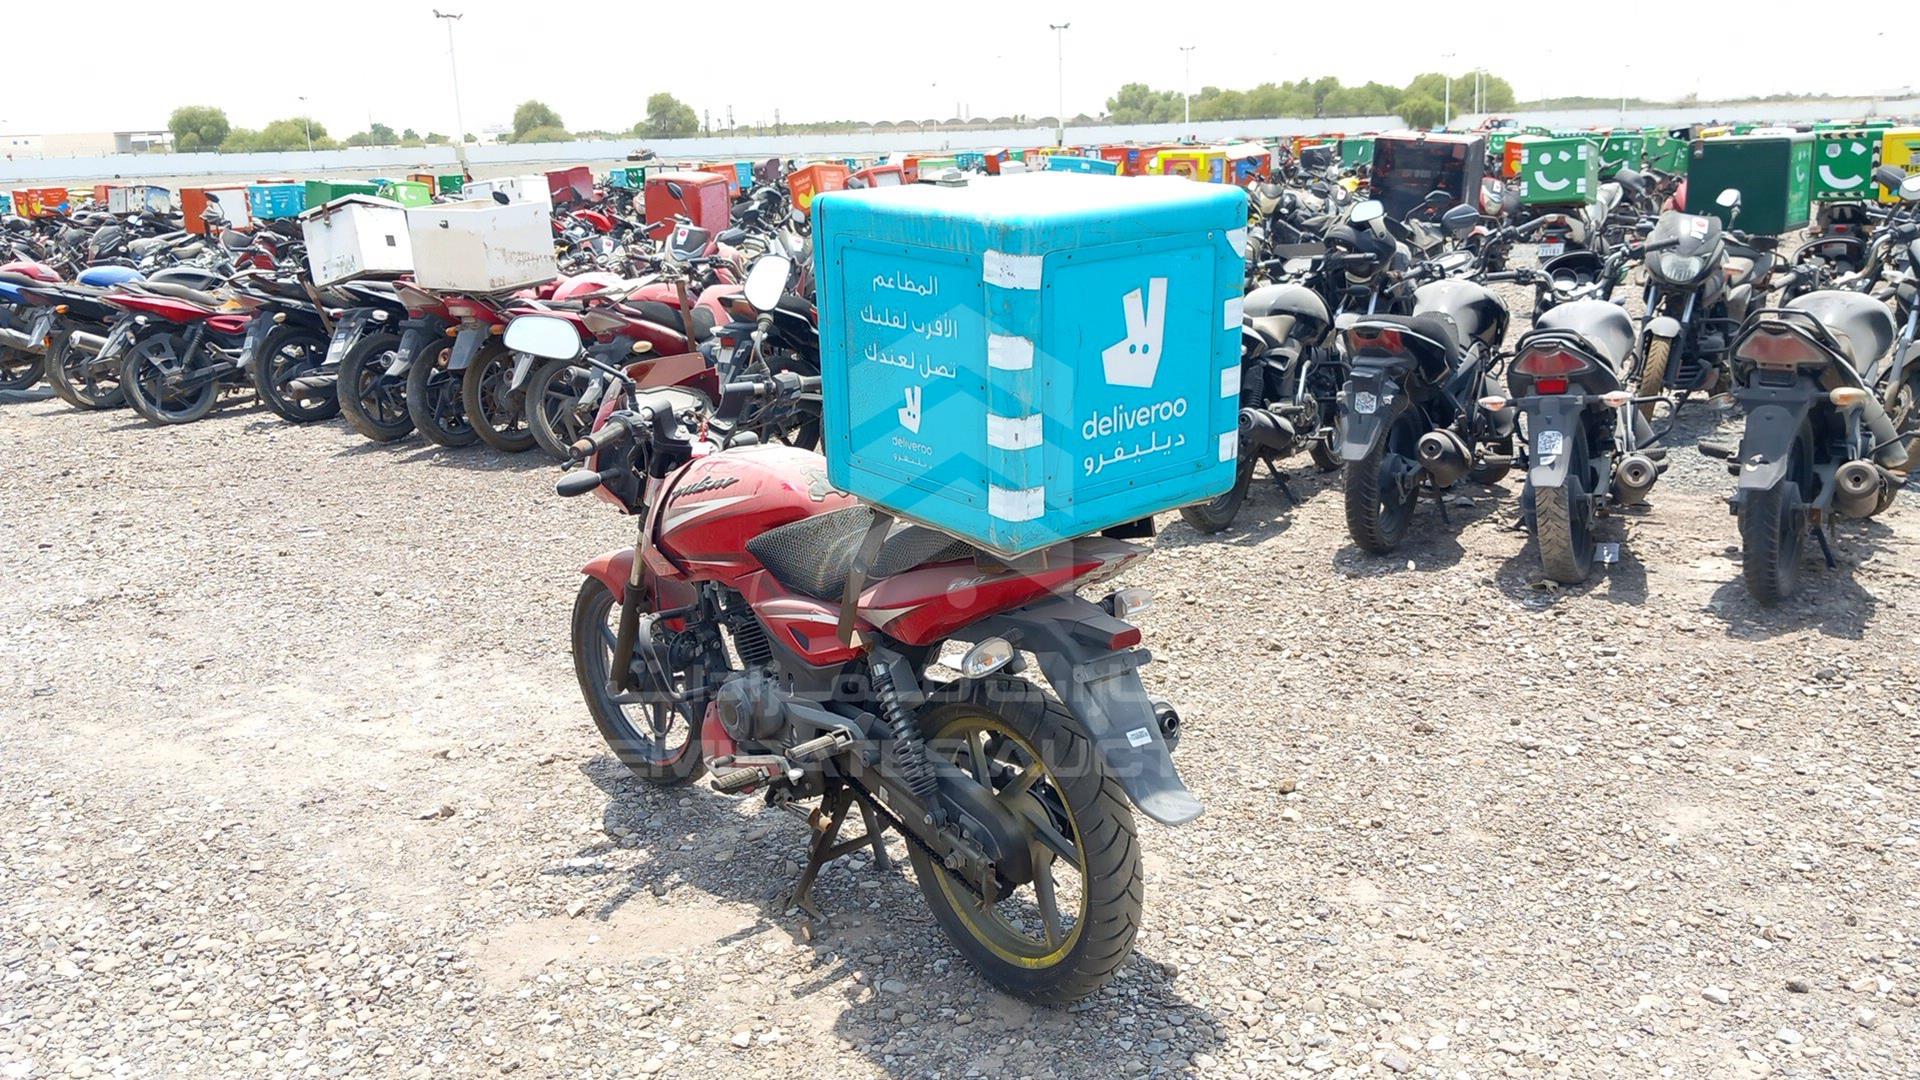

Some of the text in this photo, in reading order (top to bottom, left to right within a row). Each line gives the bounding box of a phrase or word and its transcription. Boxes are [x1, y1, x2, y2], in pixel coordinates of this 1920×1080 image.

[872, 270, 938, 297] المطاعم
[860, 304, 958, 340] الأقرب لقلبك
[864, 342, 915, 370] لعندك
[1081, 397, 1187, 441] deliveroo
[891, 434, 934, 456] deliveroo
[1083, 431, 1186, 477] ديليفرو
